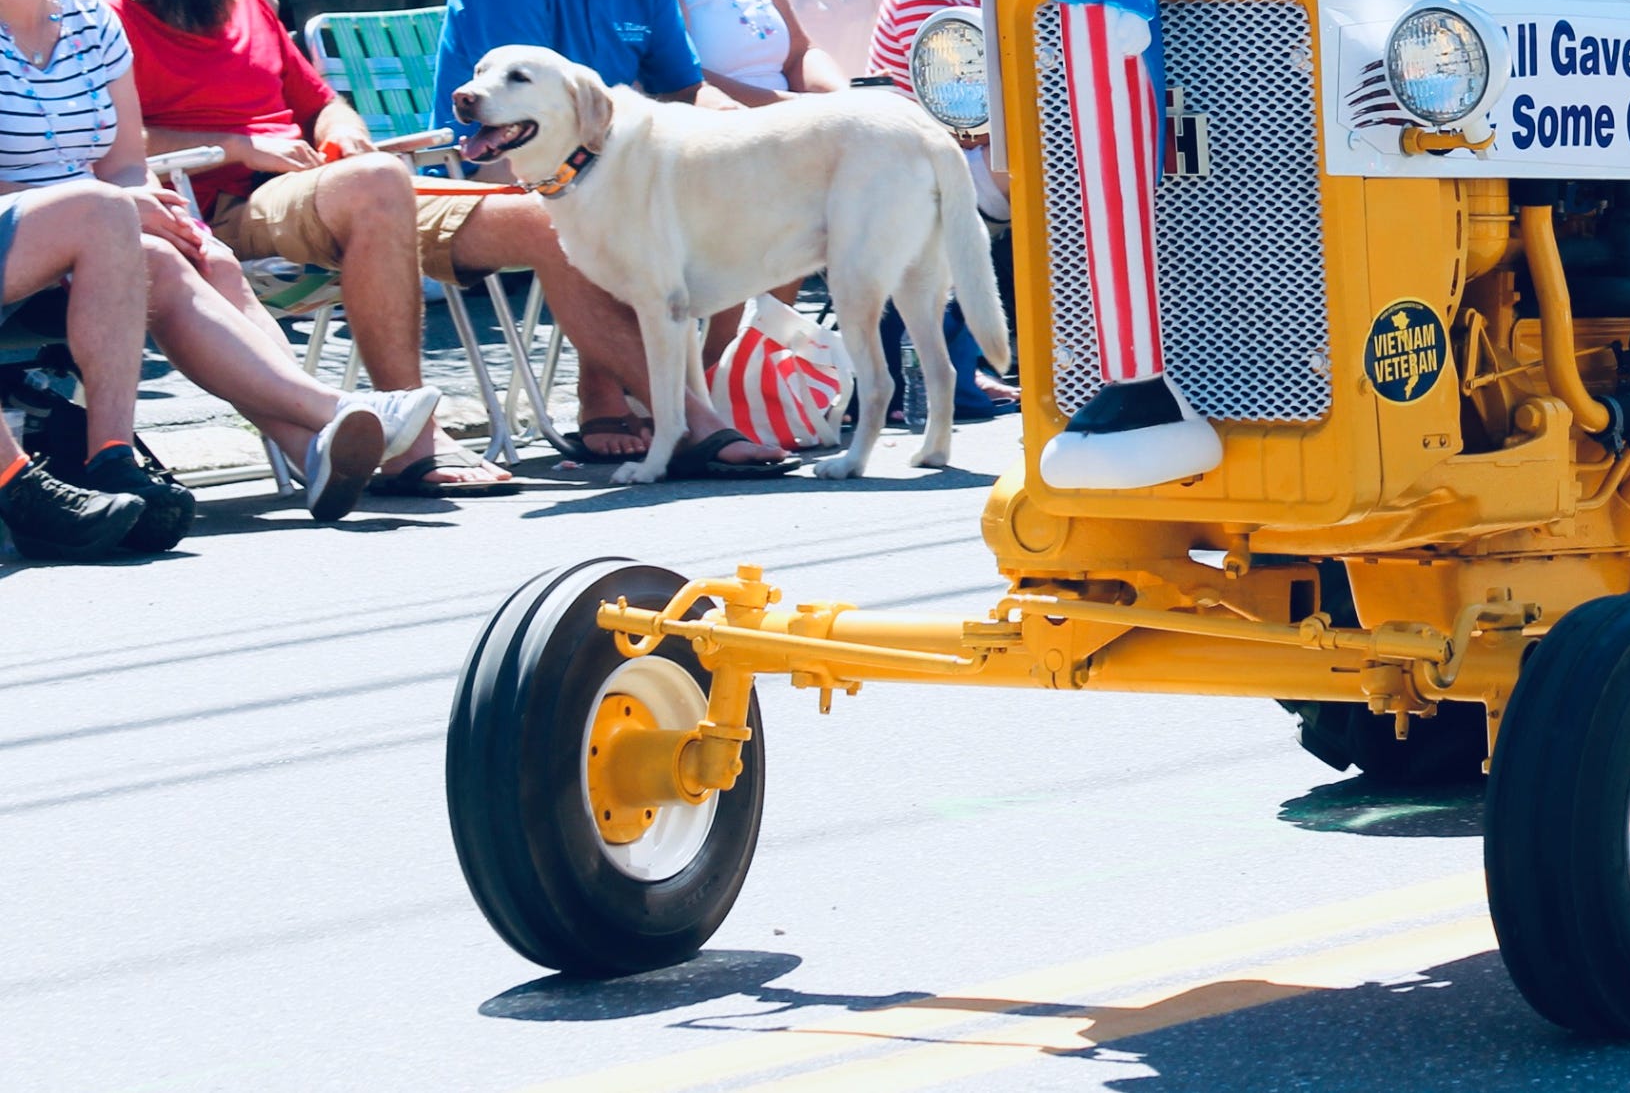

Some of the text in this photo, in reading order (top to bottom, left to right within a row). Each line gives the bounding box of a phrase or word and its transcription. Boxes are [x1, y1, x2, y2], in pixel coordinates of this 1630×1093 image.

[1502, 22, 1538, 77] ll
[1512, 93, 1615, 150] Some
[1374, 324, 1436, 356] VIETNAM
[1374, 349, 1438, 383] VETERAN
